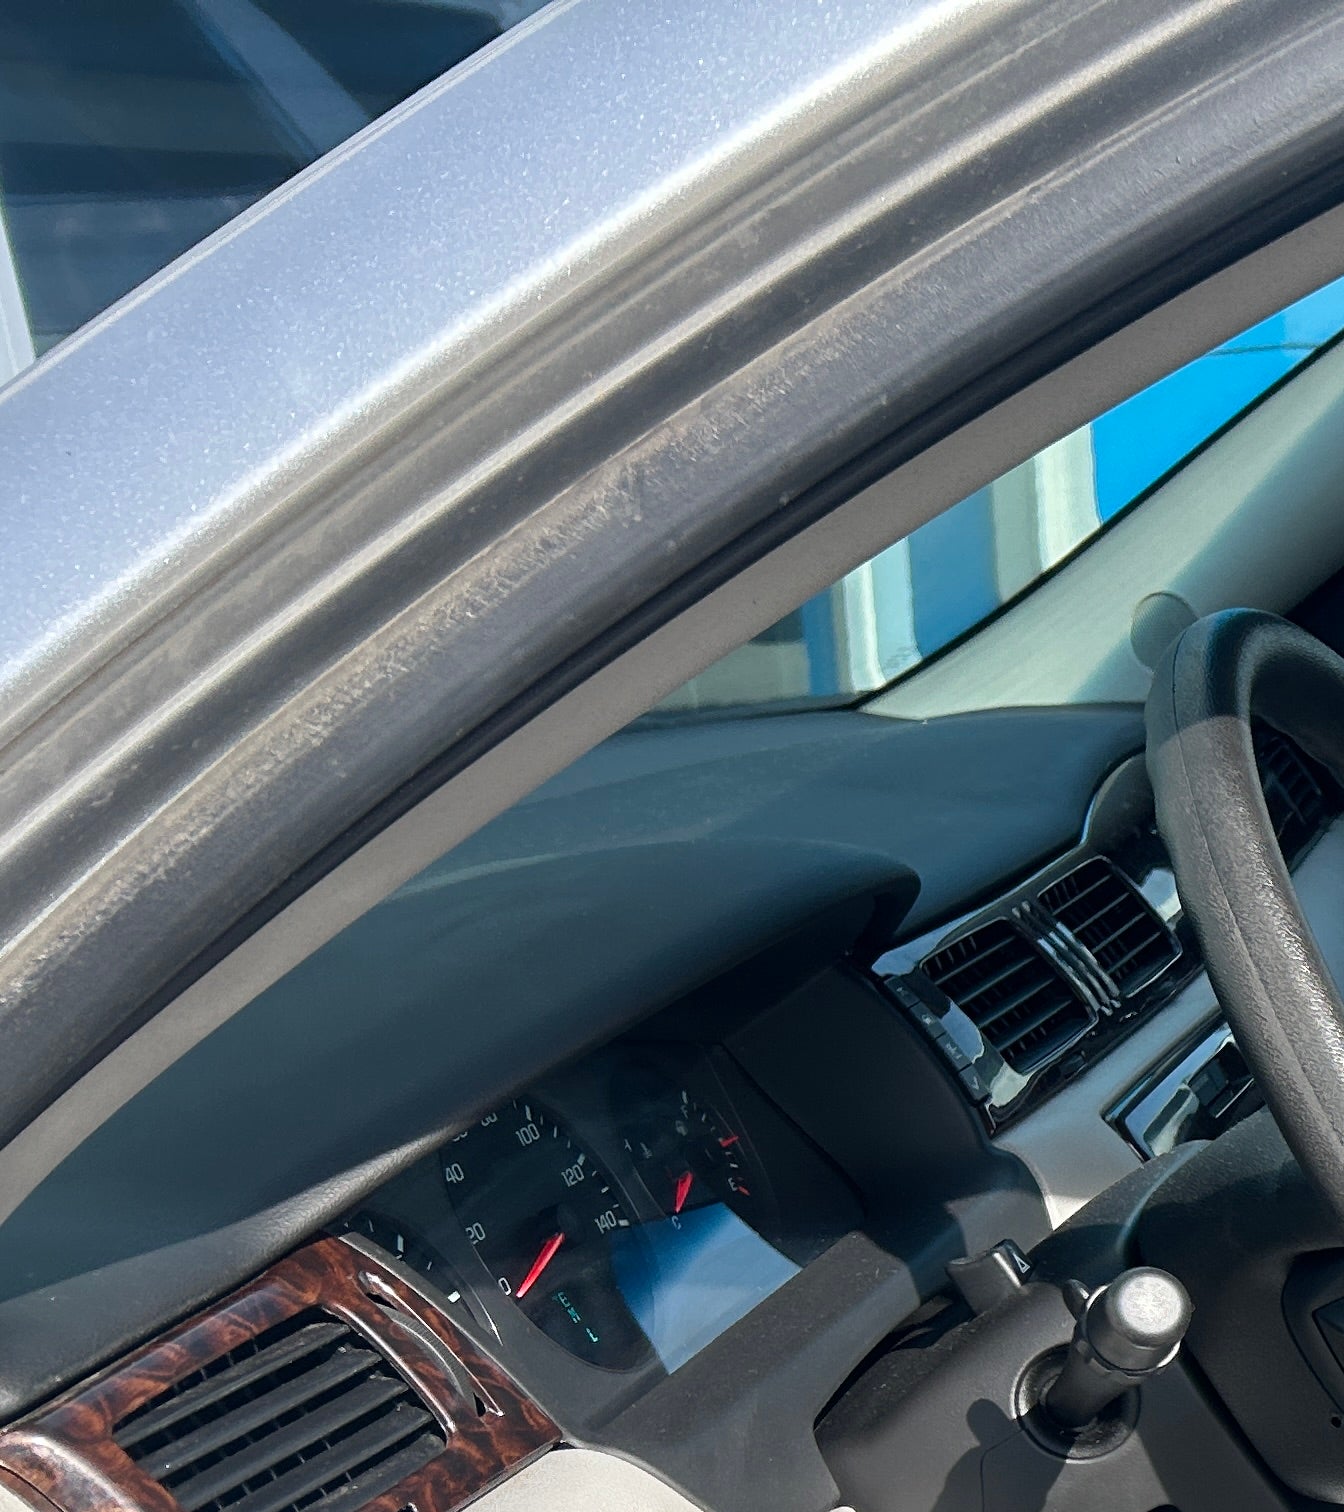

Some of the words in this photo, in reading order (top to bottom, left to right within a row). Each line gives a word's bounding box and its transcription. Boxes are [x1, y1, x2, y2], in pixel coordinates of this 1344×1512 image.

[515, 1123, 540, 1147] 100
[445, 1163, 465, 1184] 40
[561, 1164, 585, 1187] 120
[465, 1222, 486, 1245] 20
[594, 1210, 618, 1234] 140
[498, 1277, 511, 1296] 0
